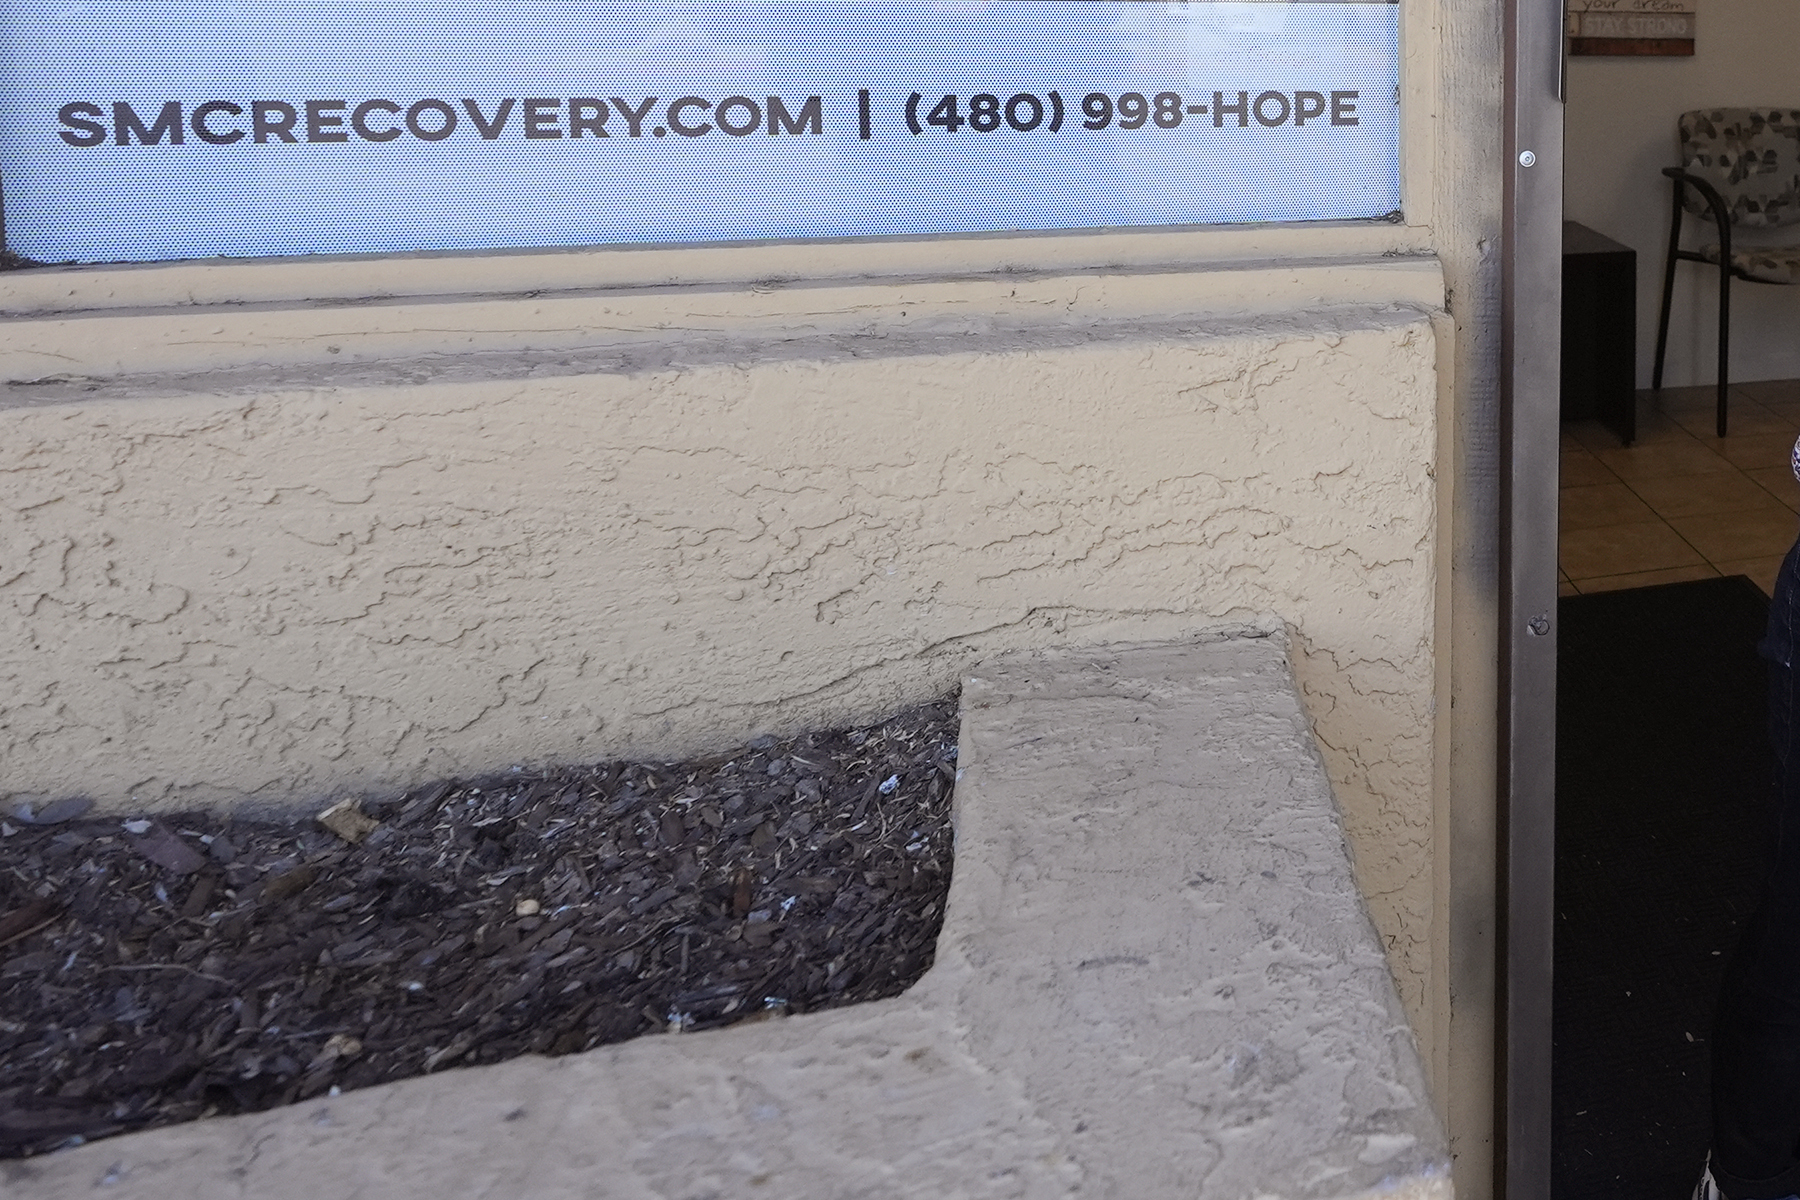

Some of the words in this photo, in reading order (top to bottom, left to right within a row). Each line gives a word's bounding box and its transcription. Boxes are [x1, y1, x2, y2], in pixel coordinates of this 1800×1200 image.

[1584, 17, 1624, 37] STAY
[1628, 17, 1688, 37] STRONG
[58, 90, 825, 148] SMCRECOVERY.COM
[903, 90, 1063, 136] (480)
[1080, 88, 1360, 133] 998-HOPE
